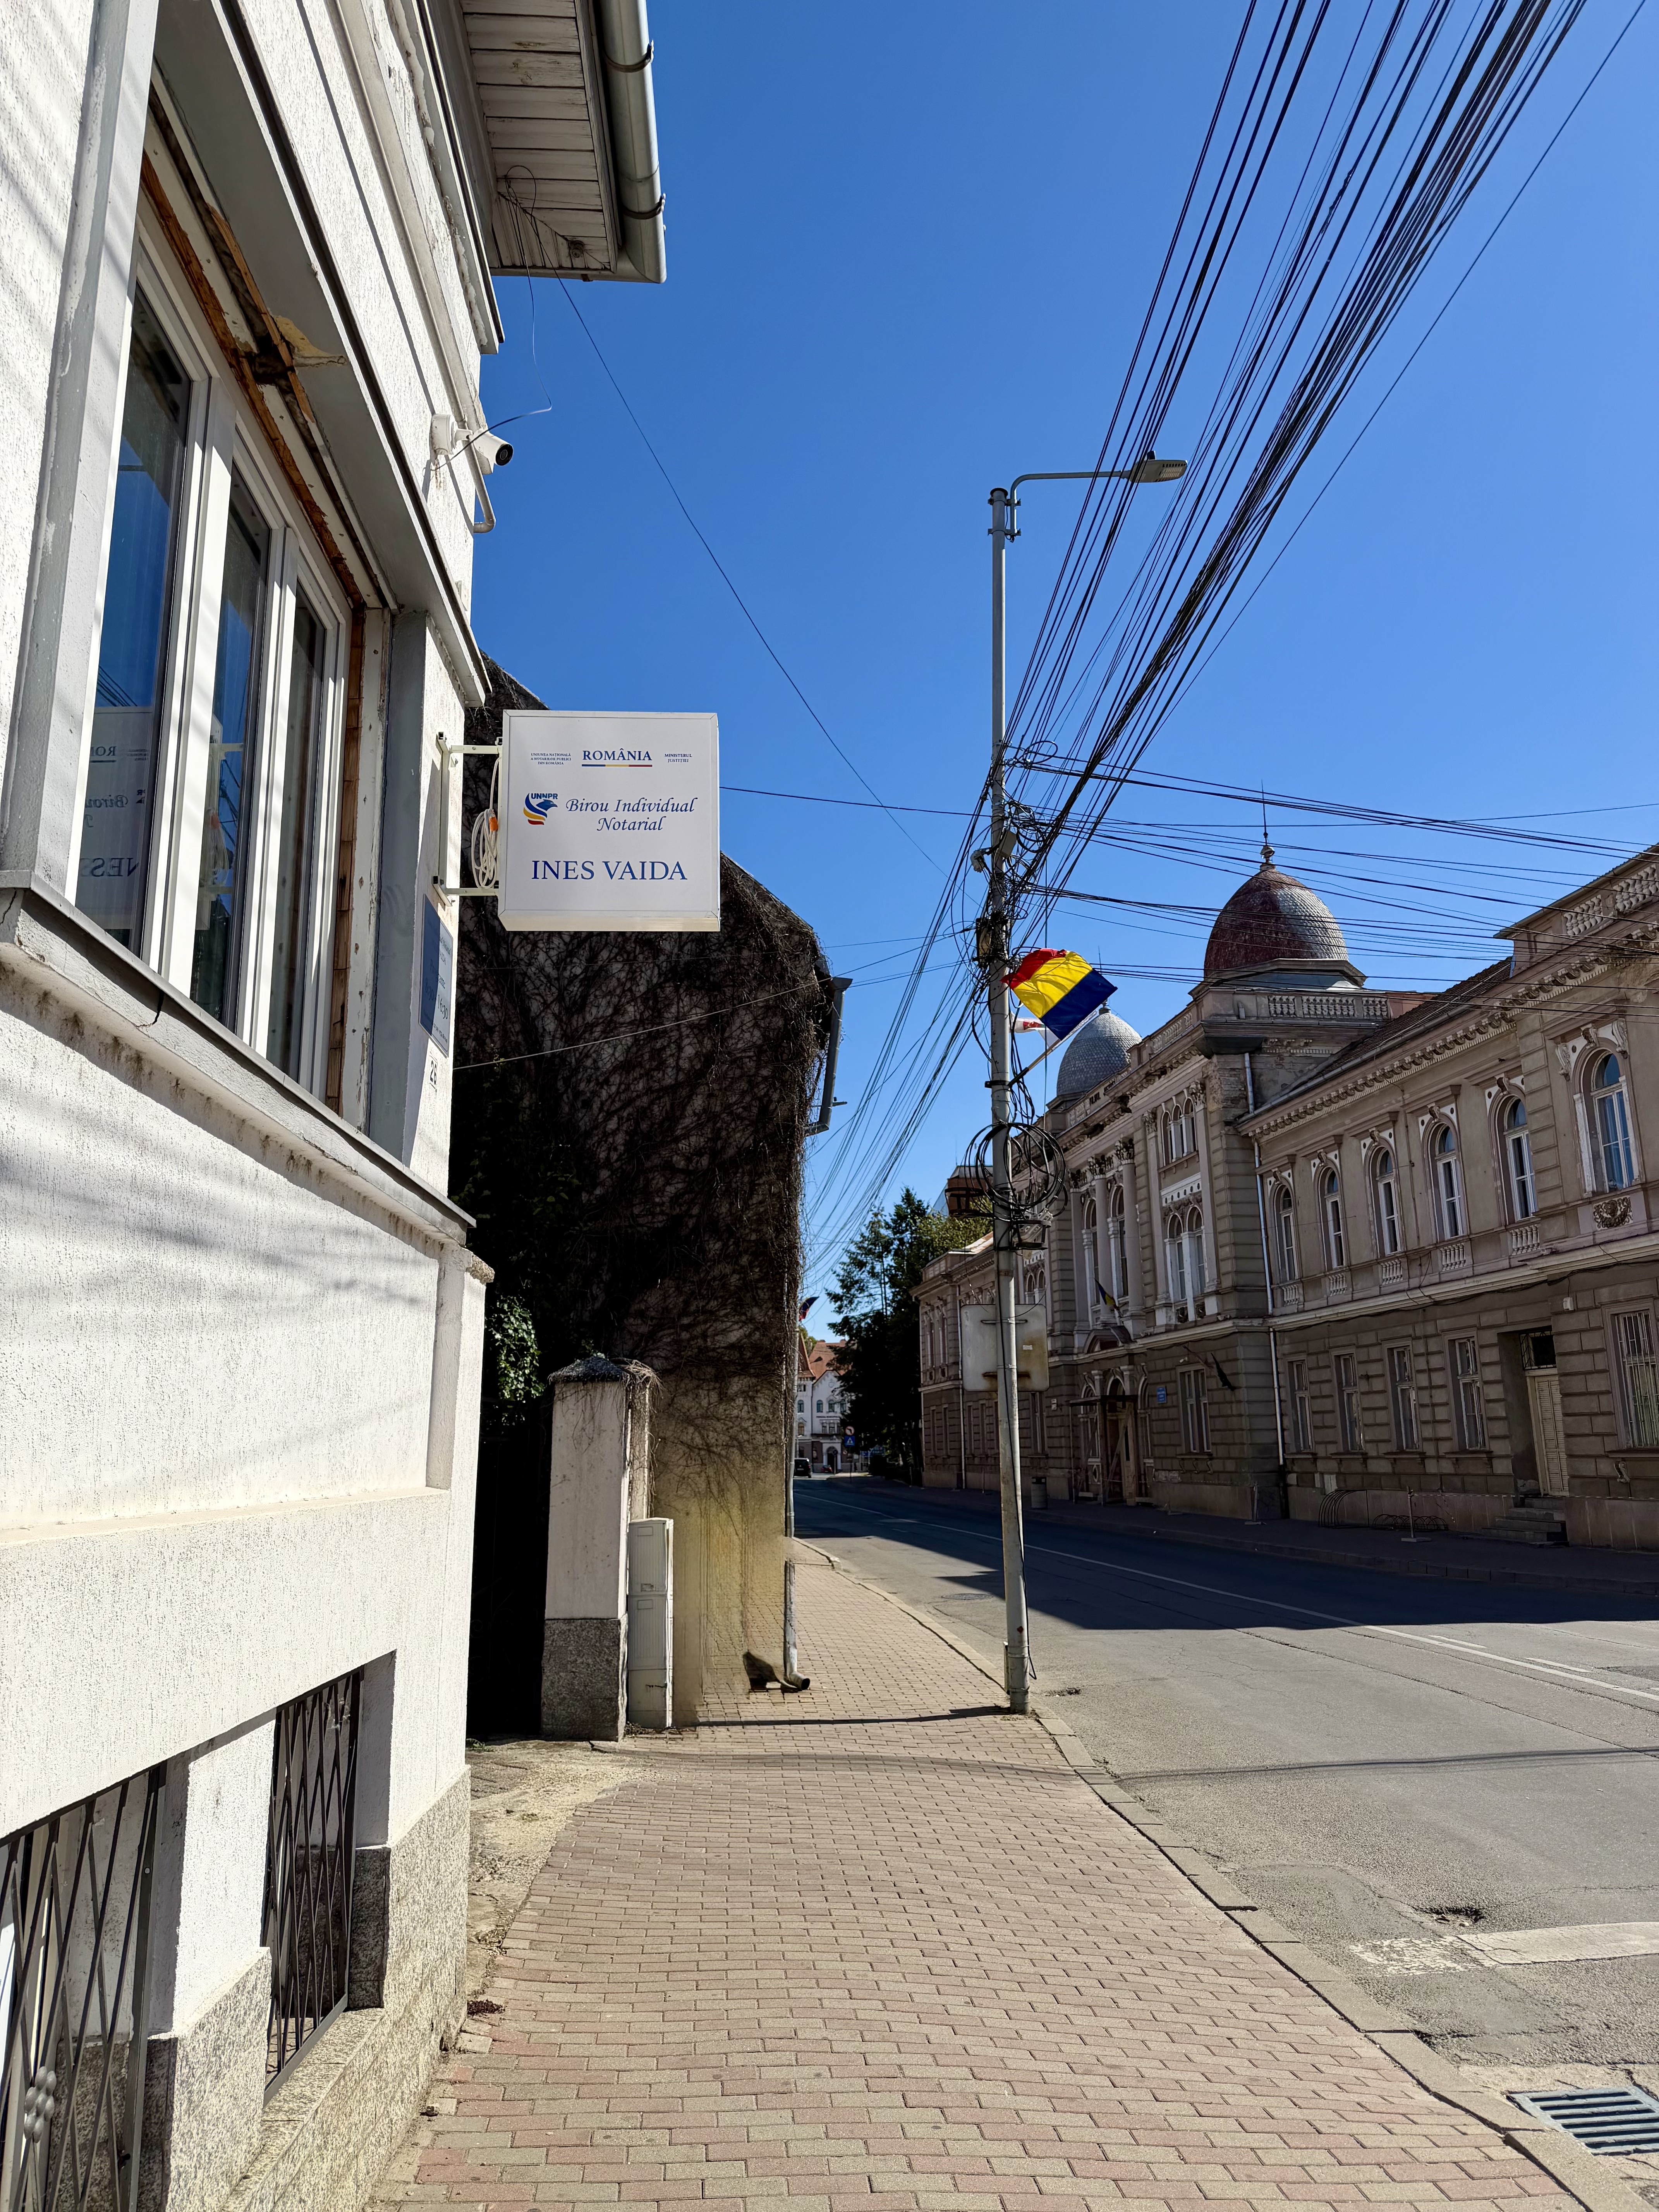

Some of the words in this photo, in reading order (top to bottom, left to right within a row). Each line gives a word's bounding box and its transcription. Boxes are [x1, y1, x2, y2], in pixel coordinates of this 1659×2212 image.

[582, 748, 653, 761] ROMÂNIA
[566, 798, 609, 812] Birou
[613, 797, 698, 812] Individual
[597, 816, 666, 831] Notarial
[532, 860, 594, 880] INES
[602, 861, 688, 880] VAIDA
[438, 994, 448, 1019] 16:30
[430, 1060, 437, 1085] 26
